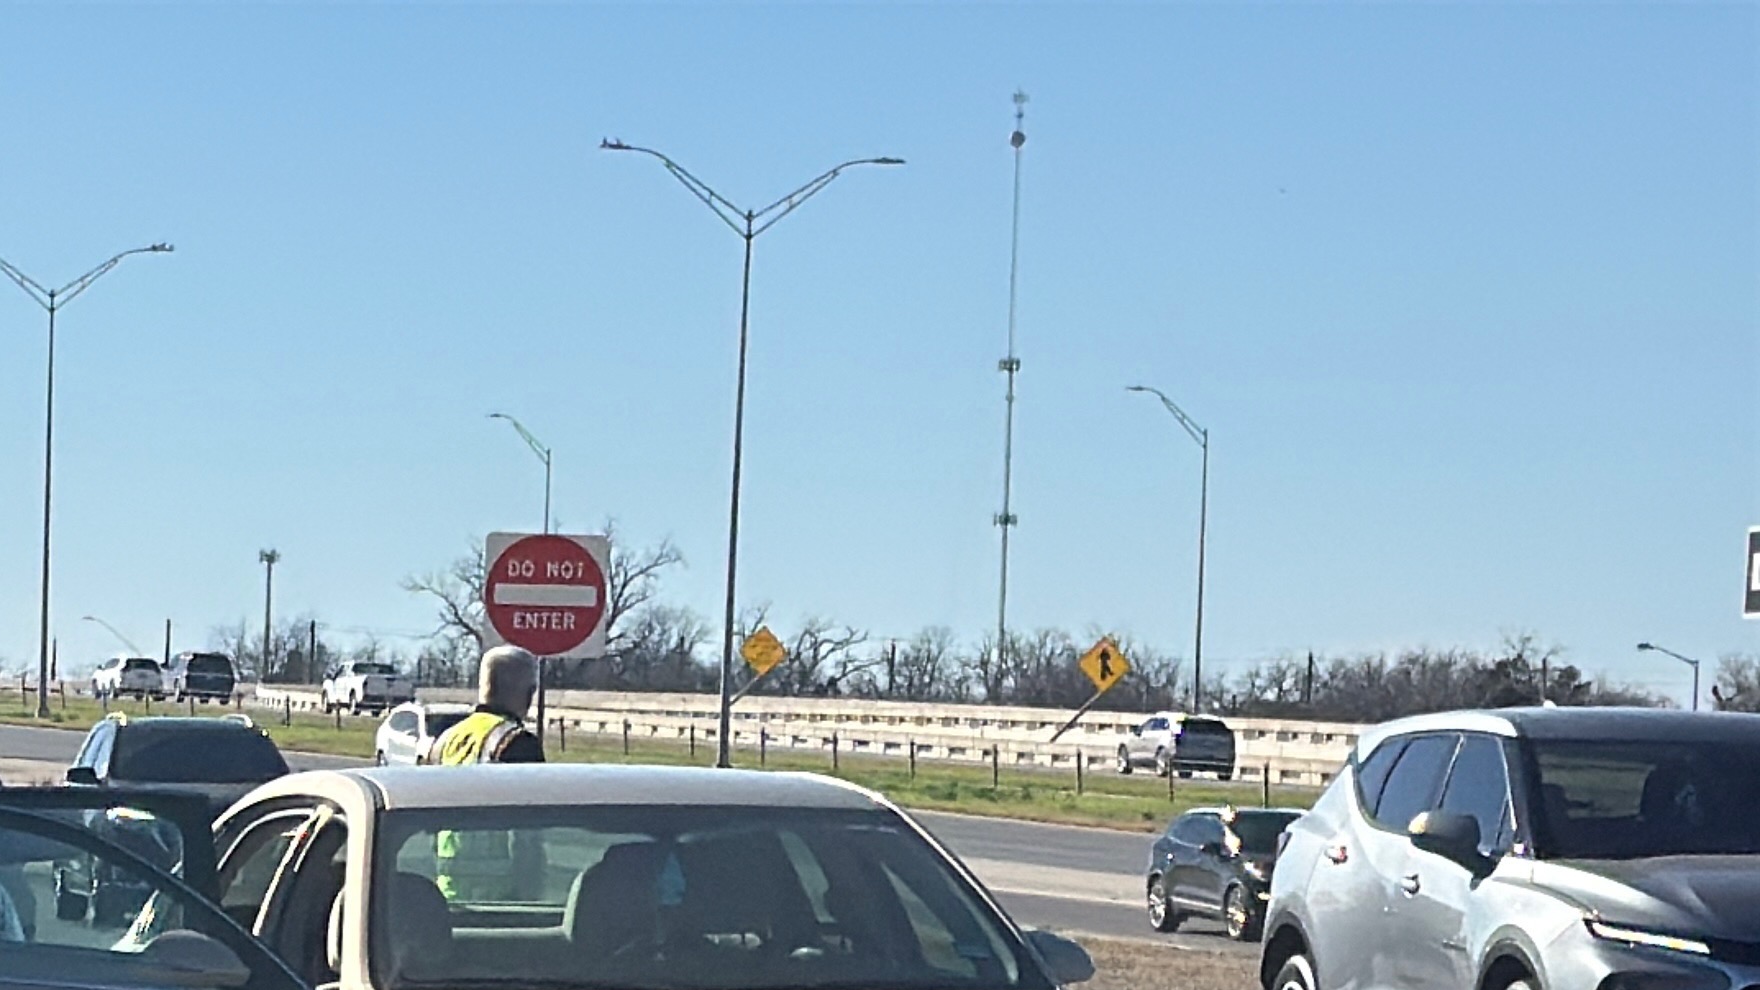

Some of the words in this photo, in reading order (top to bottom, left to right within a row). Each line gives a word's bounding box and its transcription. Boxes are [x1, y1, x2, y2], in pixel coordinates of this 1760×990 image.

[507, 559, 535, 578] DO
[546, 560, 584, 579] NOT
[513, 611, 575, 630] ENTER
